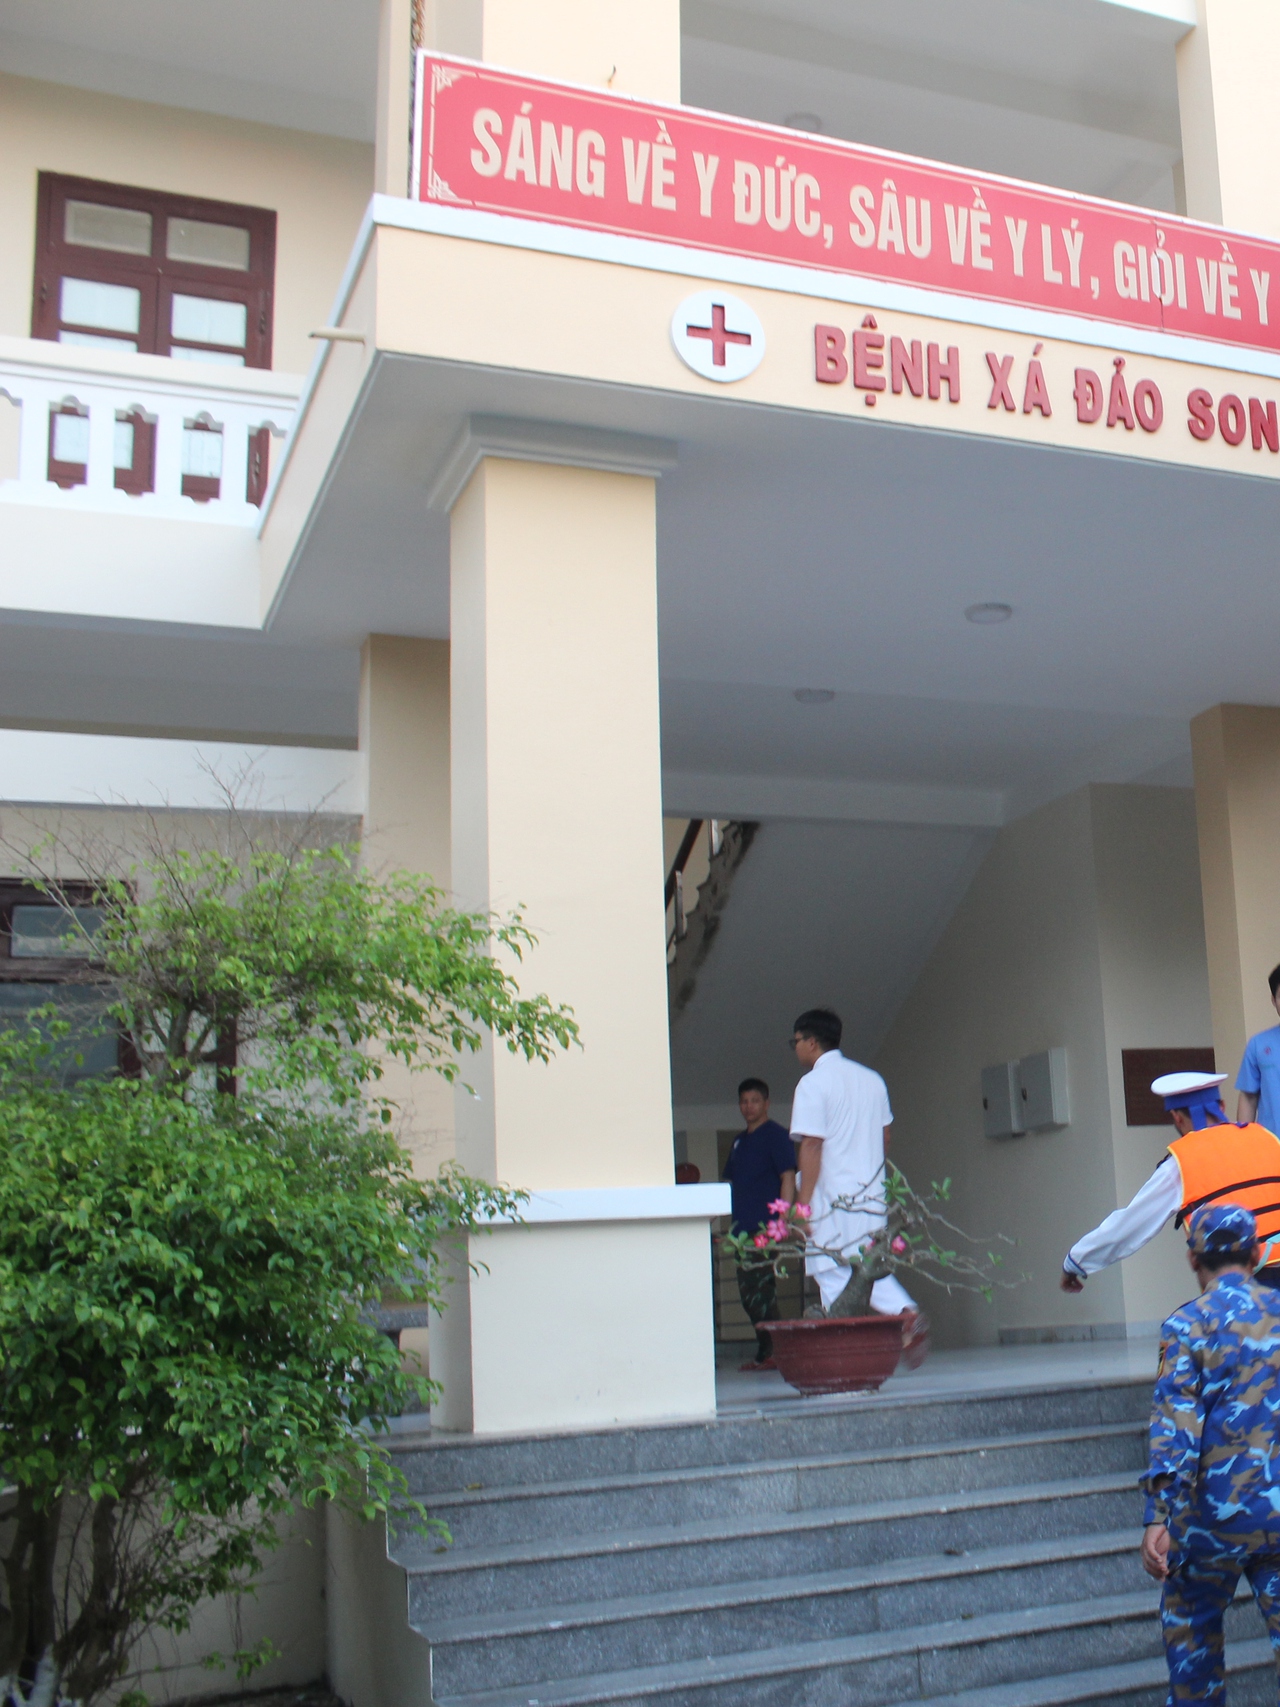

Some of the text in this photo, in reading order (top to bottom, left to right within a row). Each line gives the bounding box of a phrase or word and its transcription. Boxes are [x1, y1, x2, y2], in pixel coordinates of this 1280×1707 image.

[470, 101, 605, 198] SÁNG
[622, 118, 676, 211] VỀ
[692, 150, 719, 218] Y
[732, 155, 834, 249] ĐỨC,
[849, 178, 931, 259] SÂU
[944, 186, 993, 271] VỀ
[1004, 215, 1027, 277] Y
[1041, 218, 1100, 300] LÝ,
[1113, 229, 1187, 309] GIỎI
[1196, 240, 1242, 320] VỀ
[1249, 268, 1270, 326] Y
[814, 313, 961, 406] BỆNH
[985, 342, 1052, 417] XÁ
[1073, 356, 1164, 433] ĐẢO
